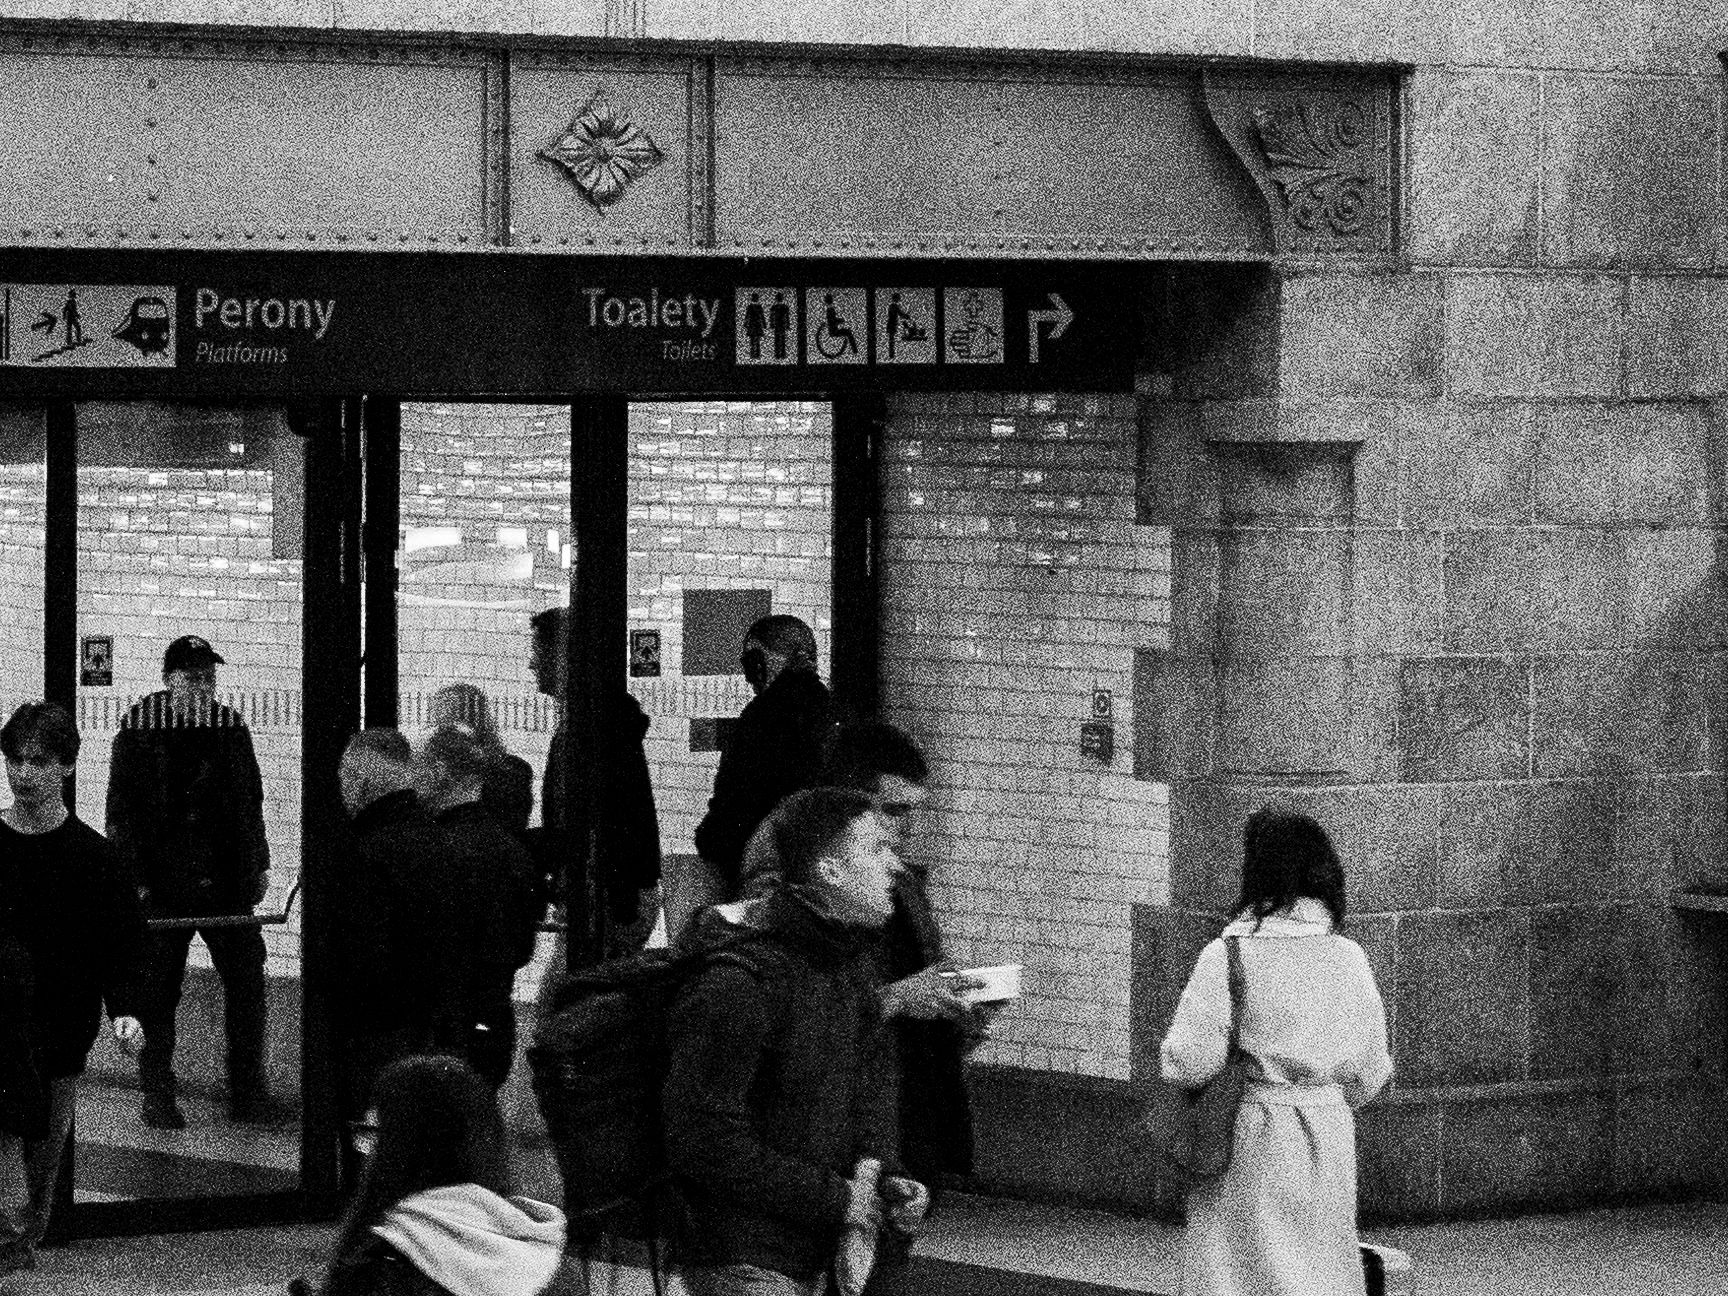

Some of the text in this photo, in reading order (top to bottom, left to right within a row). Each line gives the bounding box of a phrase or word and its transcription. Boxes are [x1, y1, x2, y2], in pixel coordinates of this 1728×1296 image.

[194, 287, 336, 339] Perony
[581, 286, 721, 337] Toalety
[194, 340, 288, 365] Platforms
[661, 339, 718, 362] Toilets
